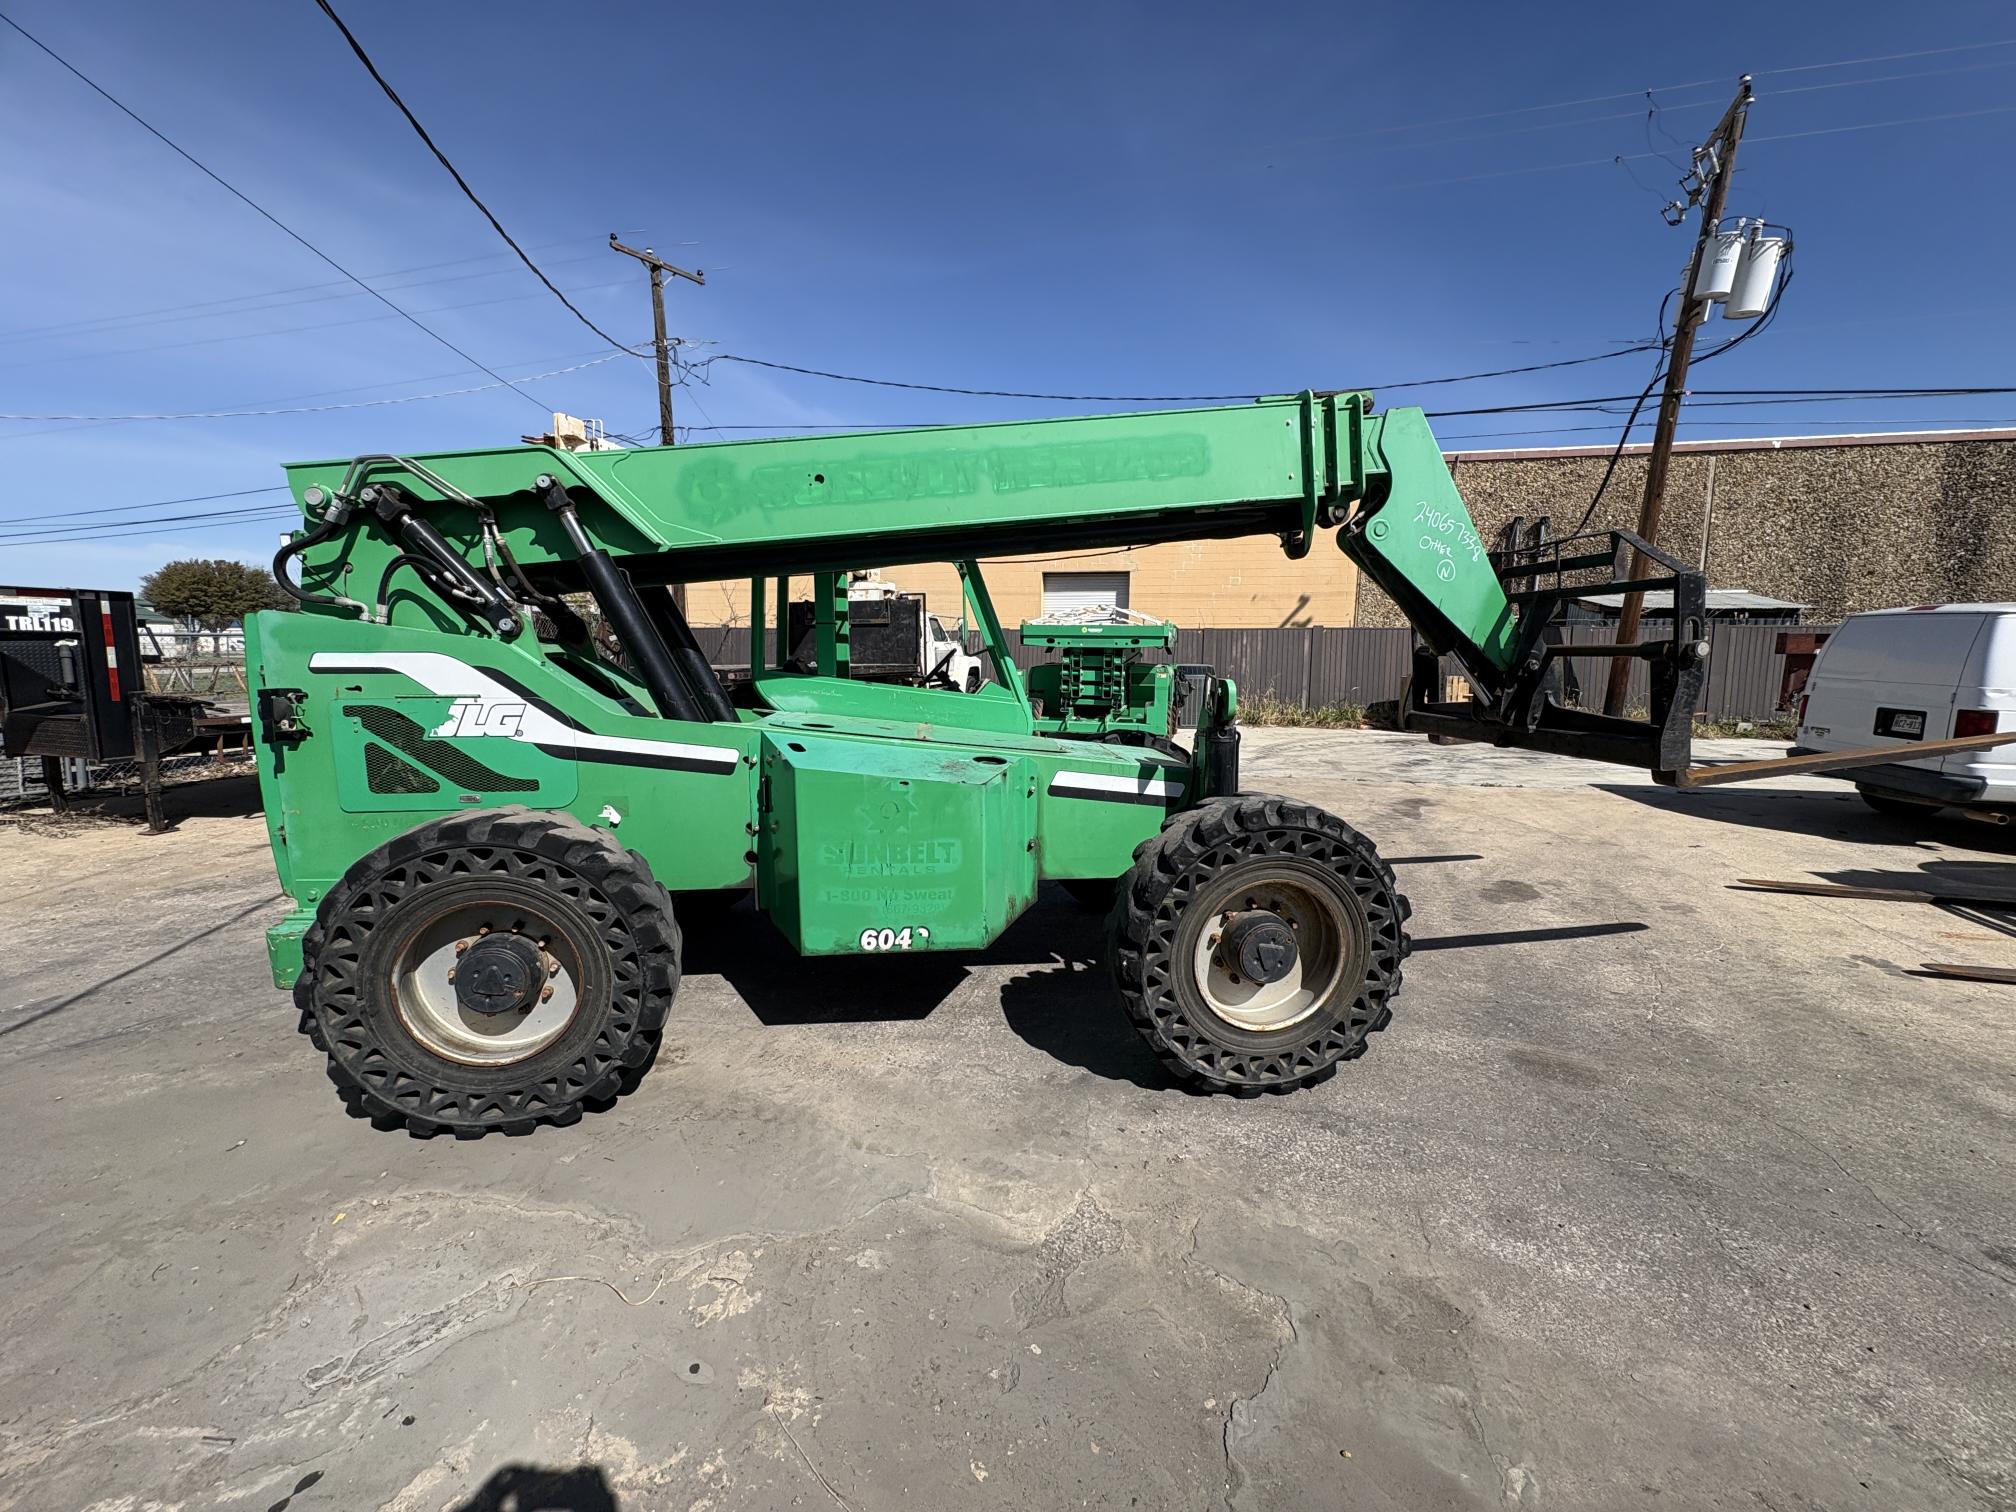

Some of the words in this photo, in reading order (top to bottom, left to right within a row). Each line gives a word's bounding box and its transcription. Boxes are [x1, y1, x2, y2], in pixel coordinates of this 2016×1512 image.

[1413, 501, 1480, 562] 240657338
[5, 615, 74, 632] TRL119
[428, 703, 527, 737] JLG
[824, 842, 955, 864] SUNBELT
